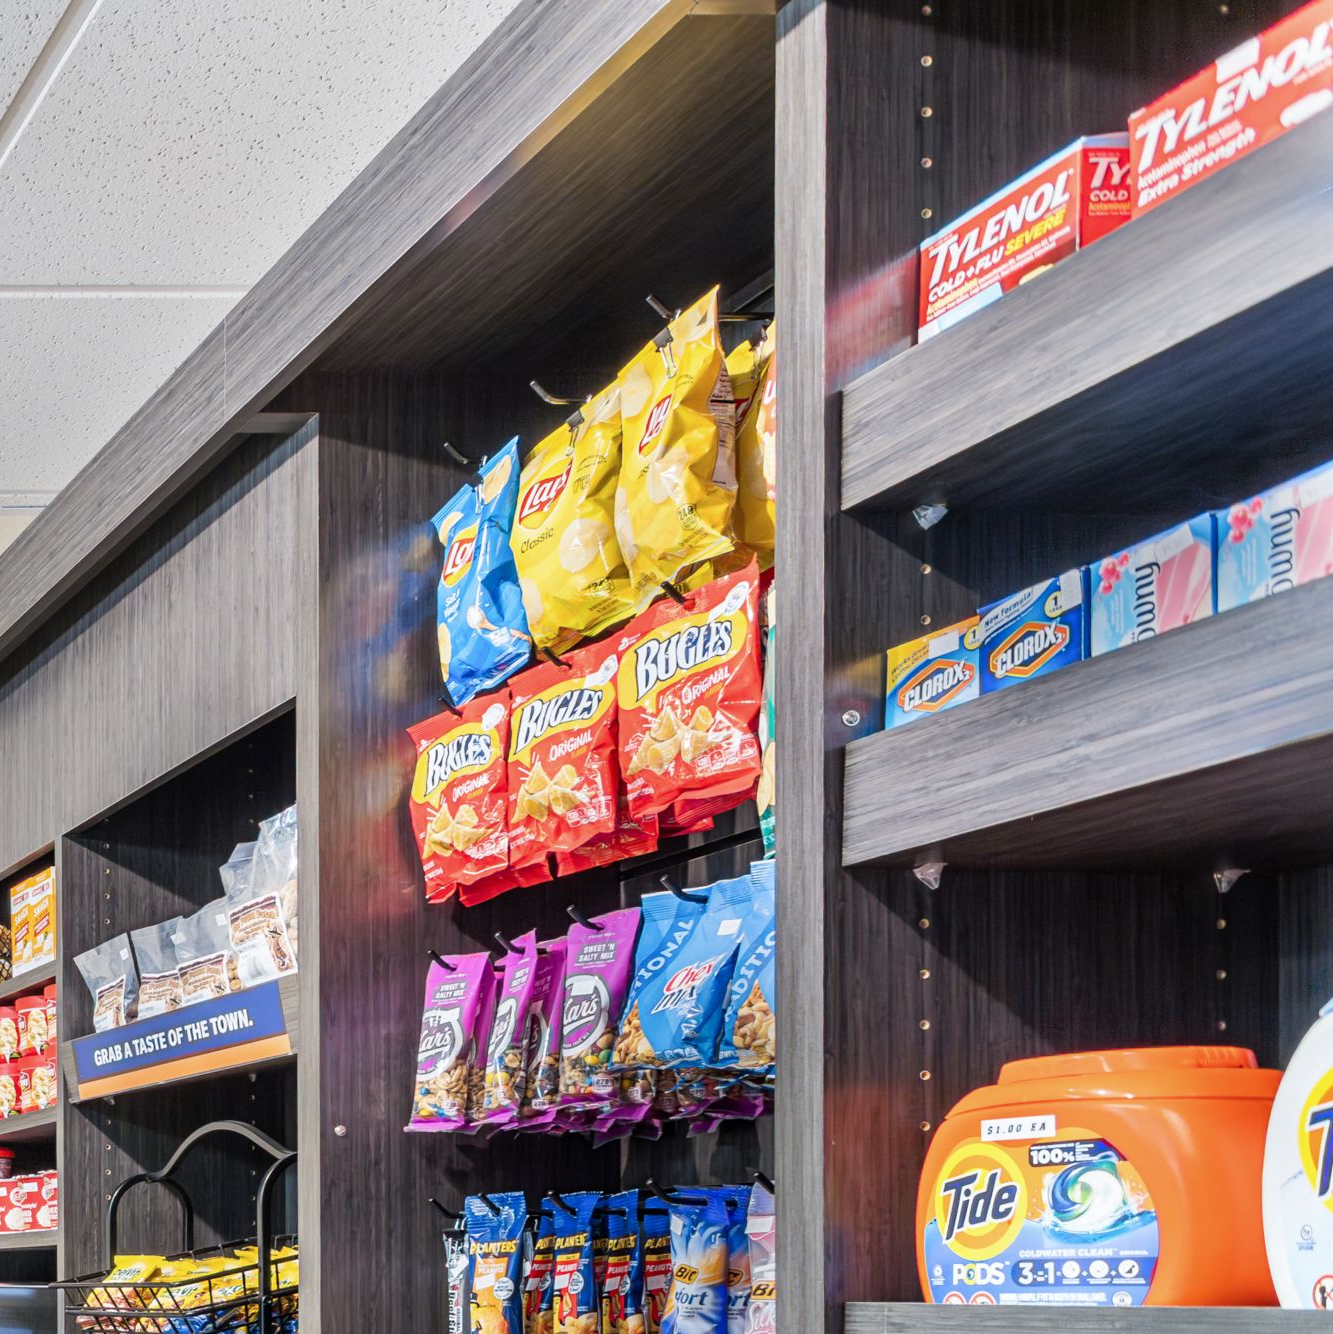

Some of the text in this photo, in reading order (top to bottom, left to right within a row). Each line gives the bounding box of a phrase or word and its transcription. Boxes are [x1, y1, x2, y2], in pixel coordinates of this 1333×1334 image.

[1136, 22, 1332, 173] TYLENOL
[1090, 191, 1128, 201] COLD
[929, 171, 1070, 289] TYLENOL
[1004, 208, 1066, 256] SEVERE
[521, 527, 554, 554] Classic
[1052, 595, 1058, 606] 1
[1134, 561, 1161, 641] owny
[971, 629, 977, 639] 1
[984, 616, 999, 628] New
[635, 621, 733, 702] BUGLES
[681, 667, 731, 704] ORIGINAL
[514, 688, 603, 756] BUGLES
[549, 729, 594, 762] ORIGINAL
[424, 734, 492, 797] BUGLES
[579, 951, 614, 961] SALTY MIX
[583, 944, 606, 953] SWEET
[94, 1009, 254, 1066] GRAB A TASTE OF THE TOWN.
[987, 1122, 1047, 1136] $1.00 EA
[1030, 1148, 1075, 1164] 100%
[943, 1168, 1017, 1243] Tide
[1019, 1250, 1076, 1258] COLDWATER
[1078, 1249, 1113, 1257] CLEAN
